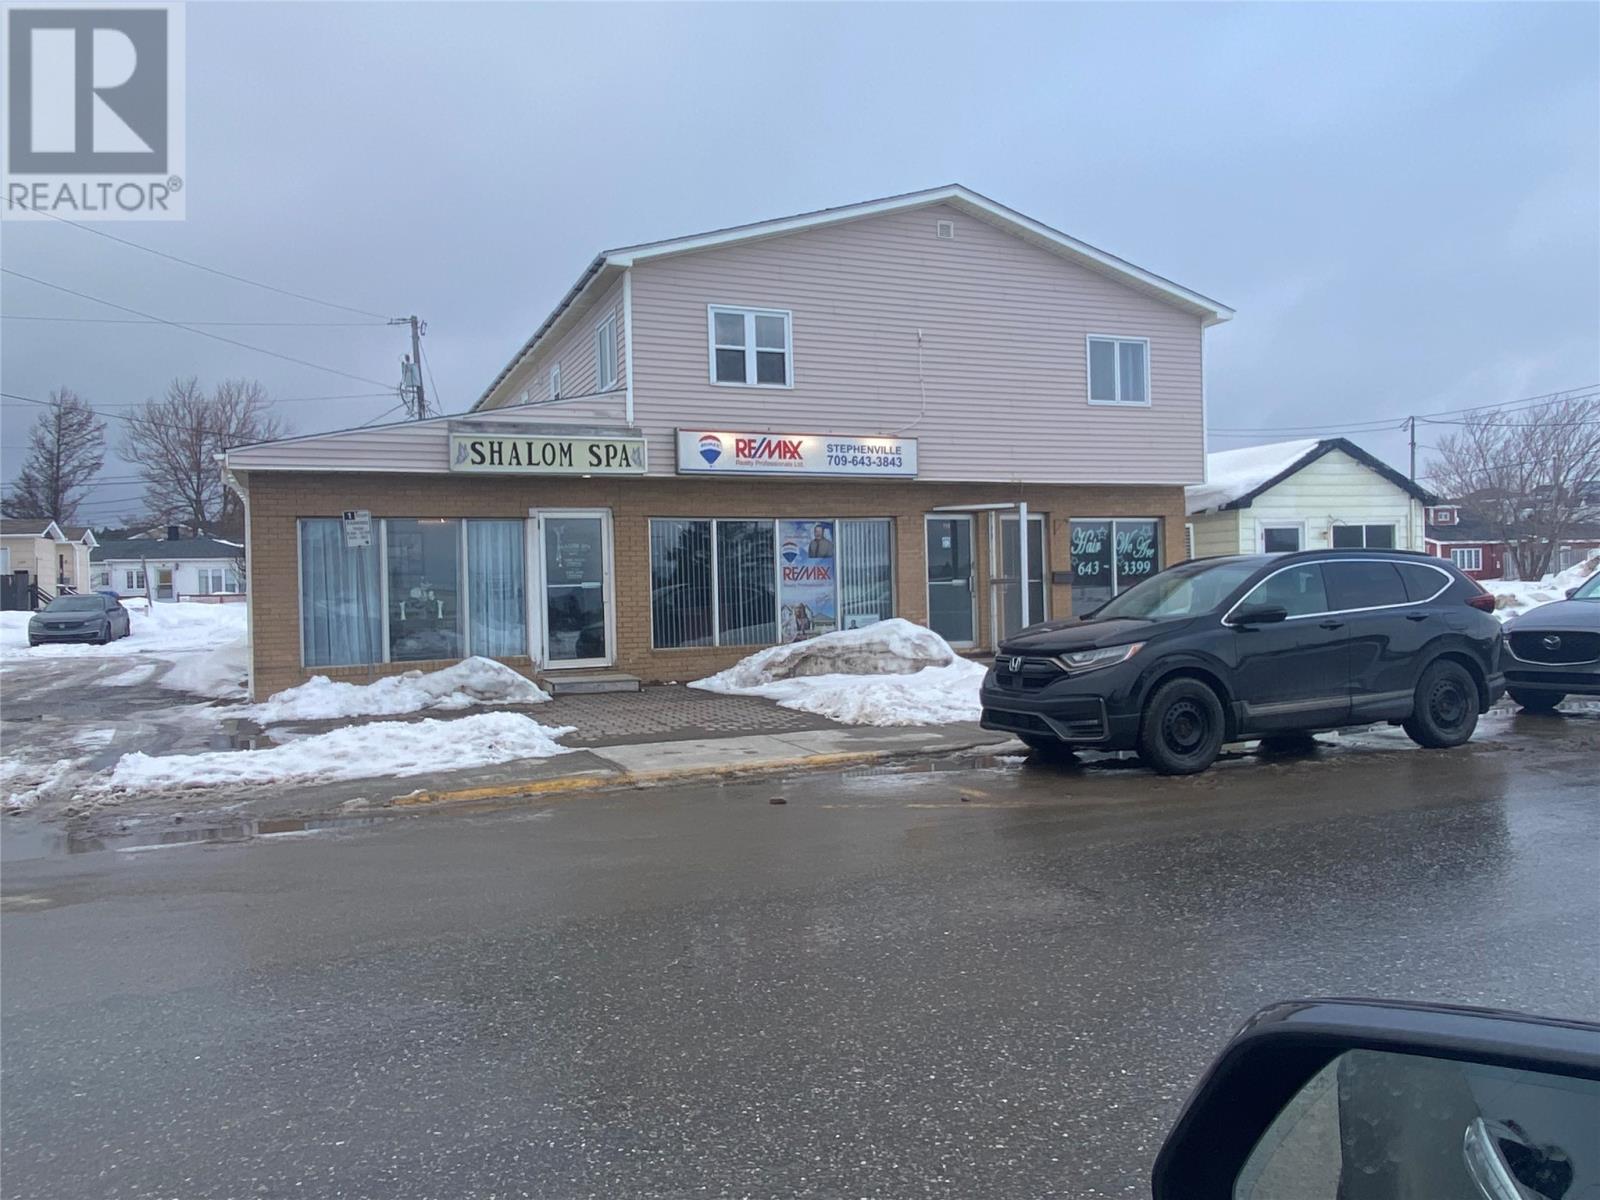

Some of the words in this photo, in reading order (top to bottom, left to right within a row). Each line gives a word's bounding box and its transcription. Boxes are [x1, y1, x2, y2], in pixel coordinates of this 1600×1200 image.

[470, 441, 574, 467] SHALOM
[588, 444, 632, 468] SPA
[736, 437, 804, 460] RE/MAX
[826, 443, 902, 455] STEPHENVILLE
[827, 455, 903, 467] 709-643-3843
[782, 565, 832, 581] RE/MAX
[1078, 560, 1100, 576] 643
[1121, 560, 1151, 576] 3399
